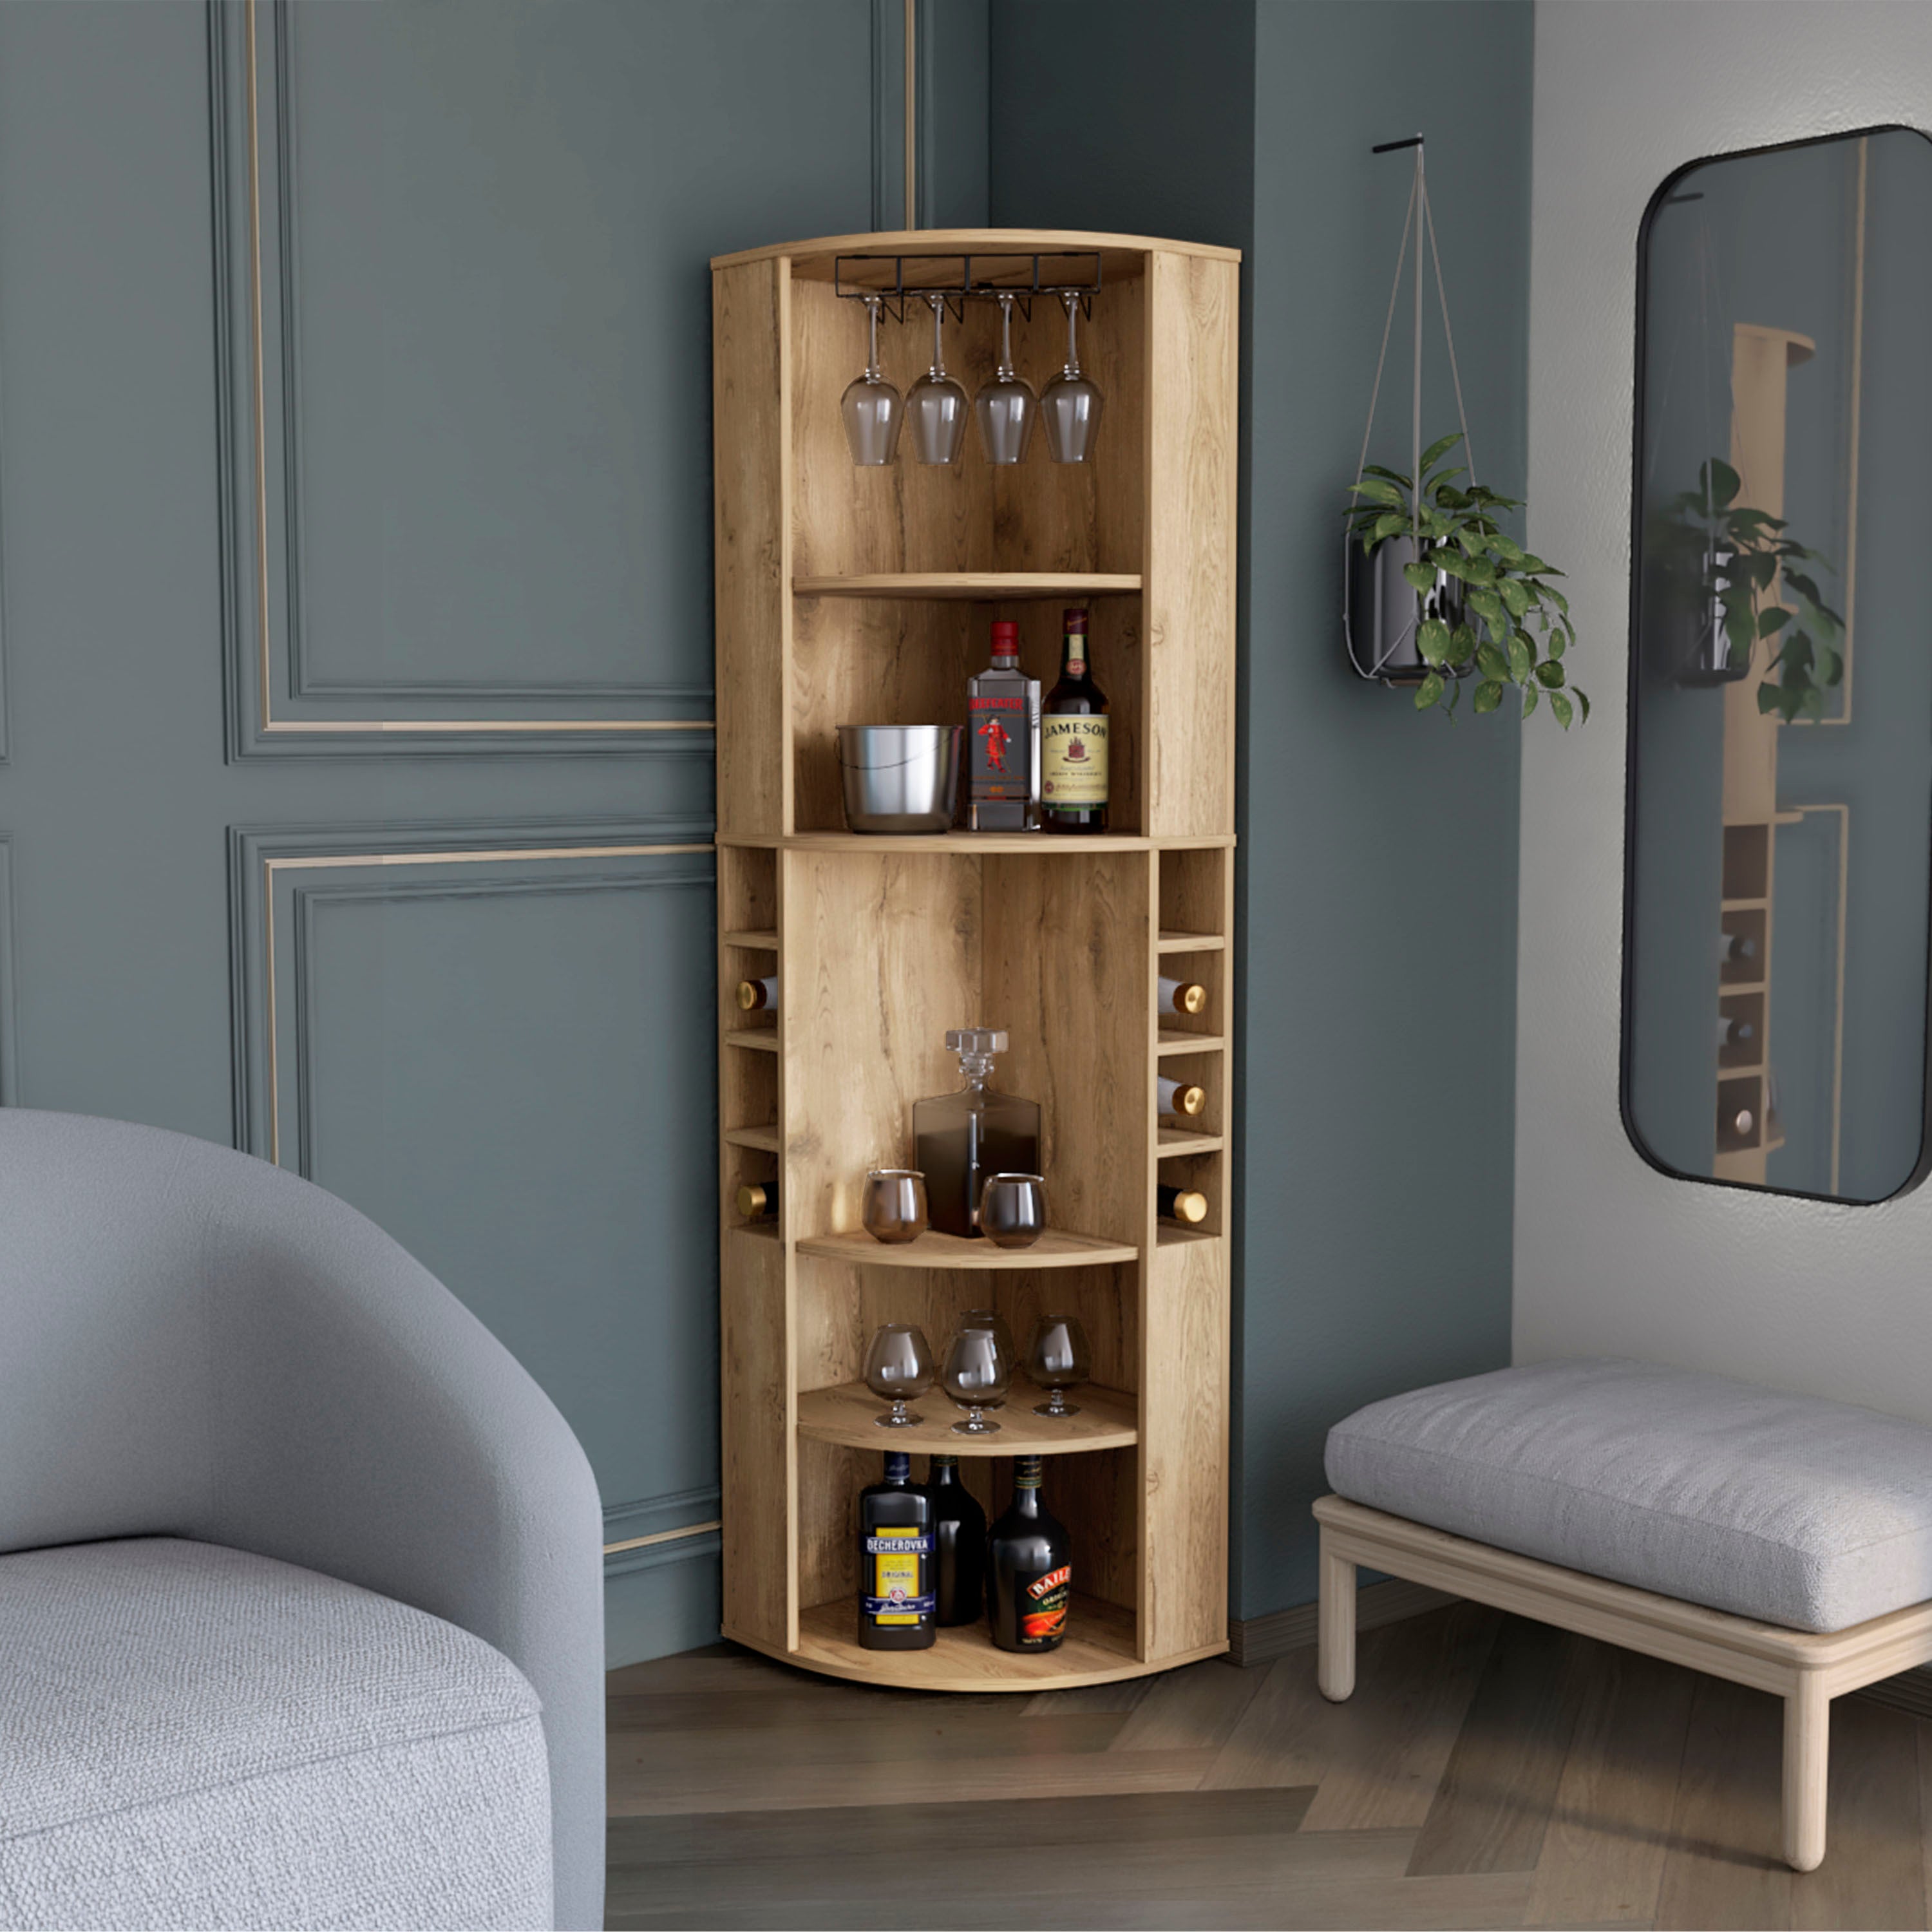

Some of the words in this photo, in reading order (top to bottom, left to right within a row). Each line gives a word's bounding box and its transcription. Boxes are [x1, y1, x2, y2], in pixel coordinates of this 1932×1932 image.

[969, 697, 1023, 711] BEEFEATER
[1045, 723, 1106, 739] JAMESON
[867, 1539, 928, 1551] BECHEROVKA
